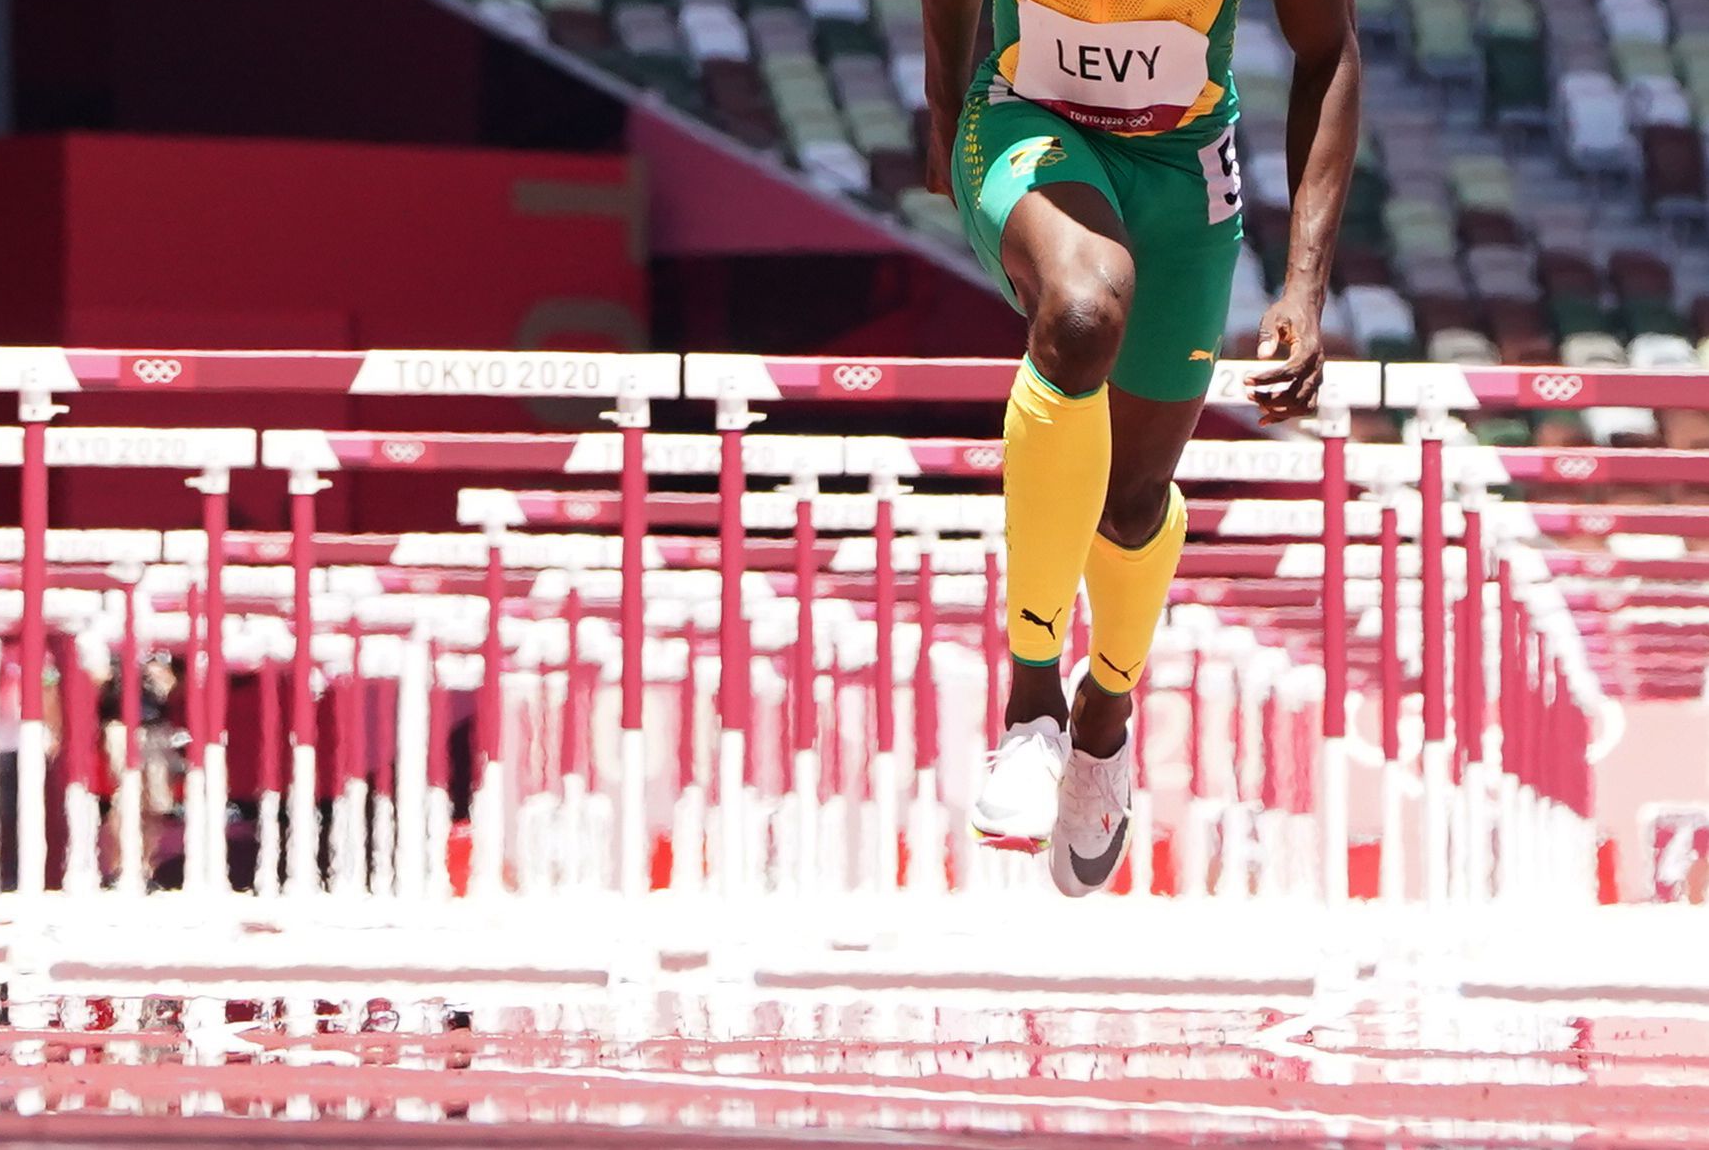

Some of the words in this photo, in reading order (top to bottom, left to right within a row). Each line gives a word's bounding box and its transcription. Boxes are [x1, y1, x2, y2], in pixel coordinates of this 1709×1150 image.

[1056, 38, 1162, 83] LEVY
[394, 359, 506, 390] TOKYO
[517, 360, 600, 390] 2020
[118, 438, 187, 462] 2020
[1185, 450, 1279, 475] TOKYO
[1288, 452, 1359, 477] 200
